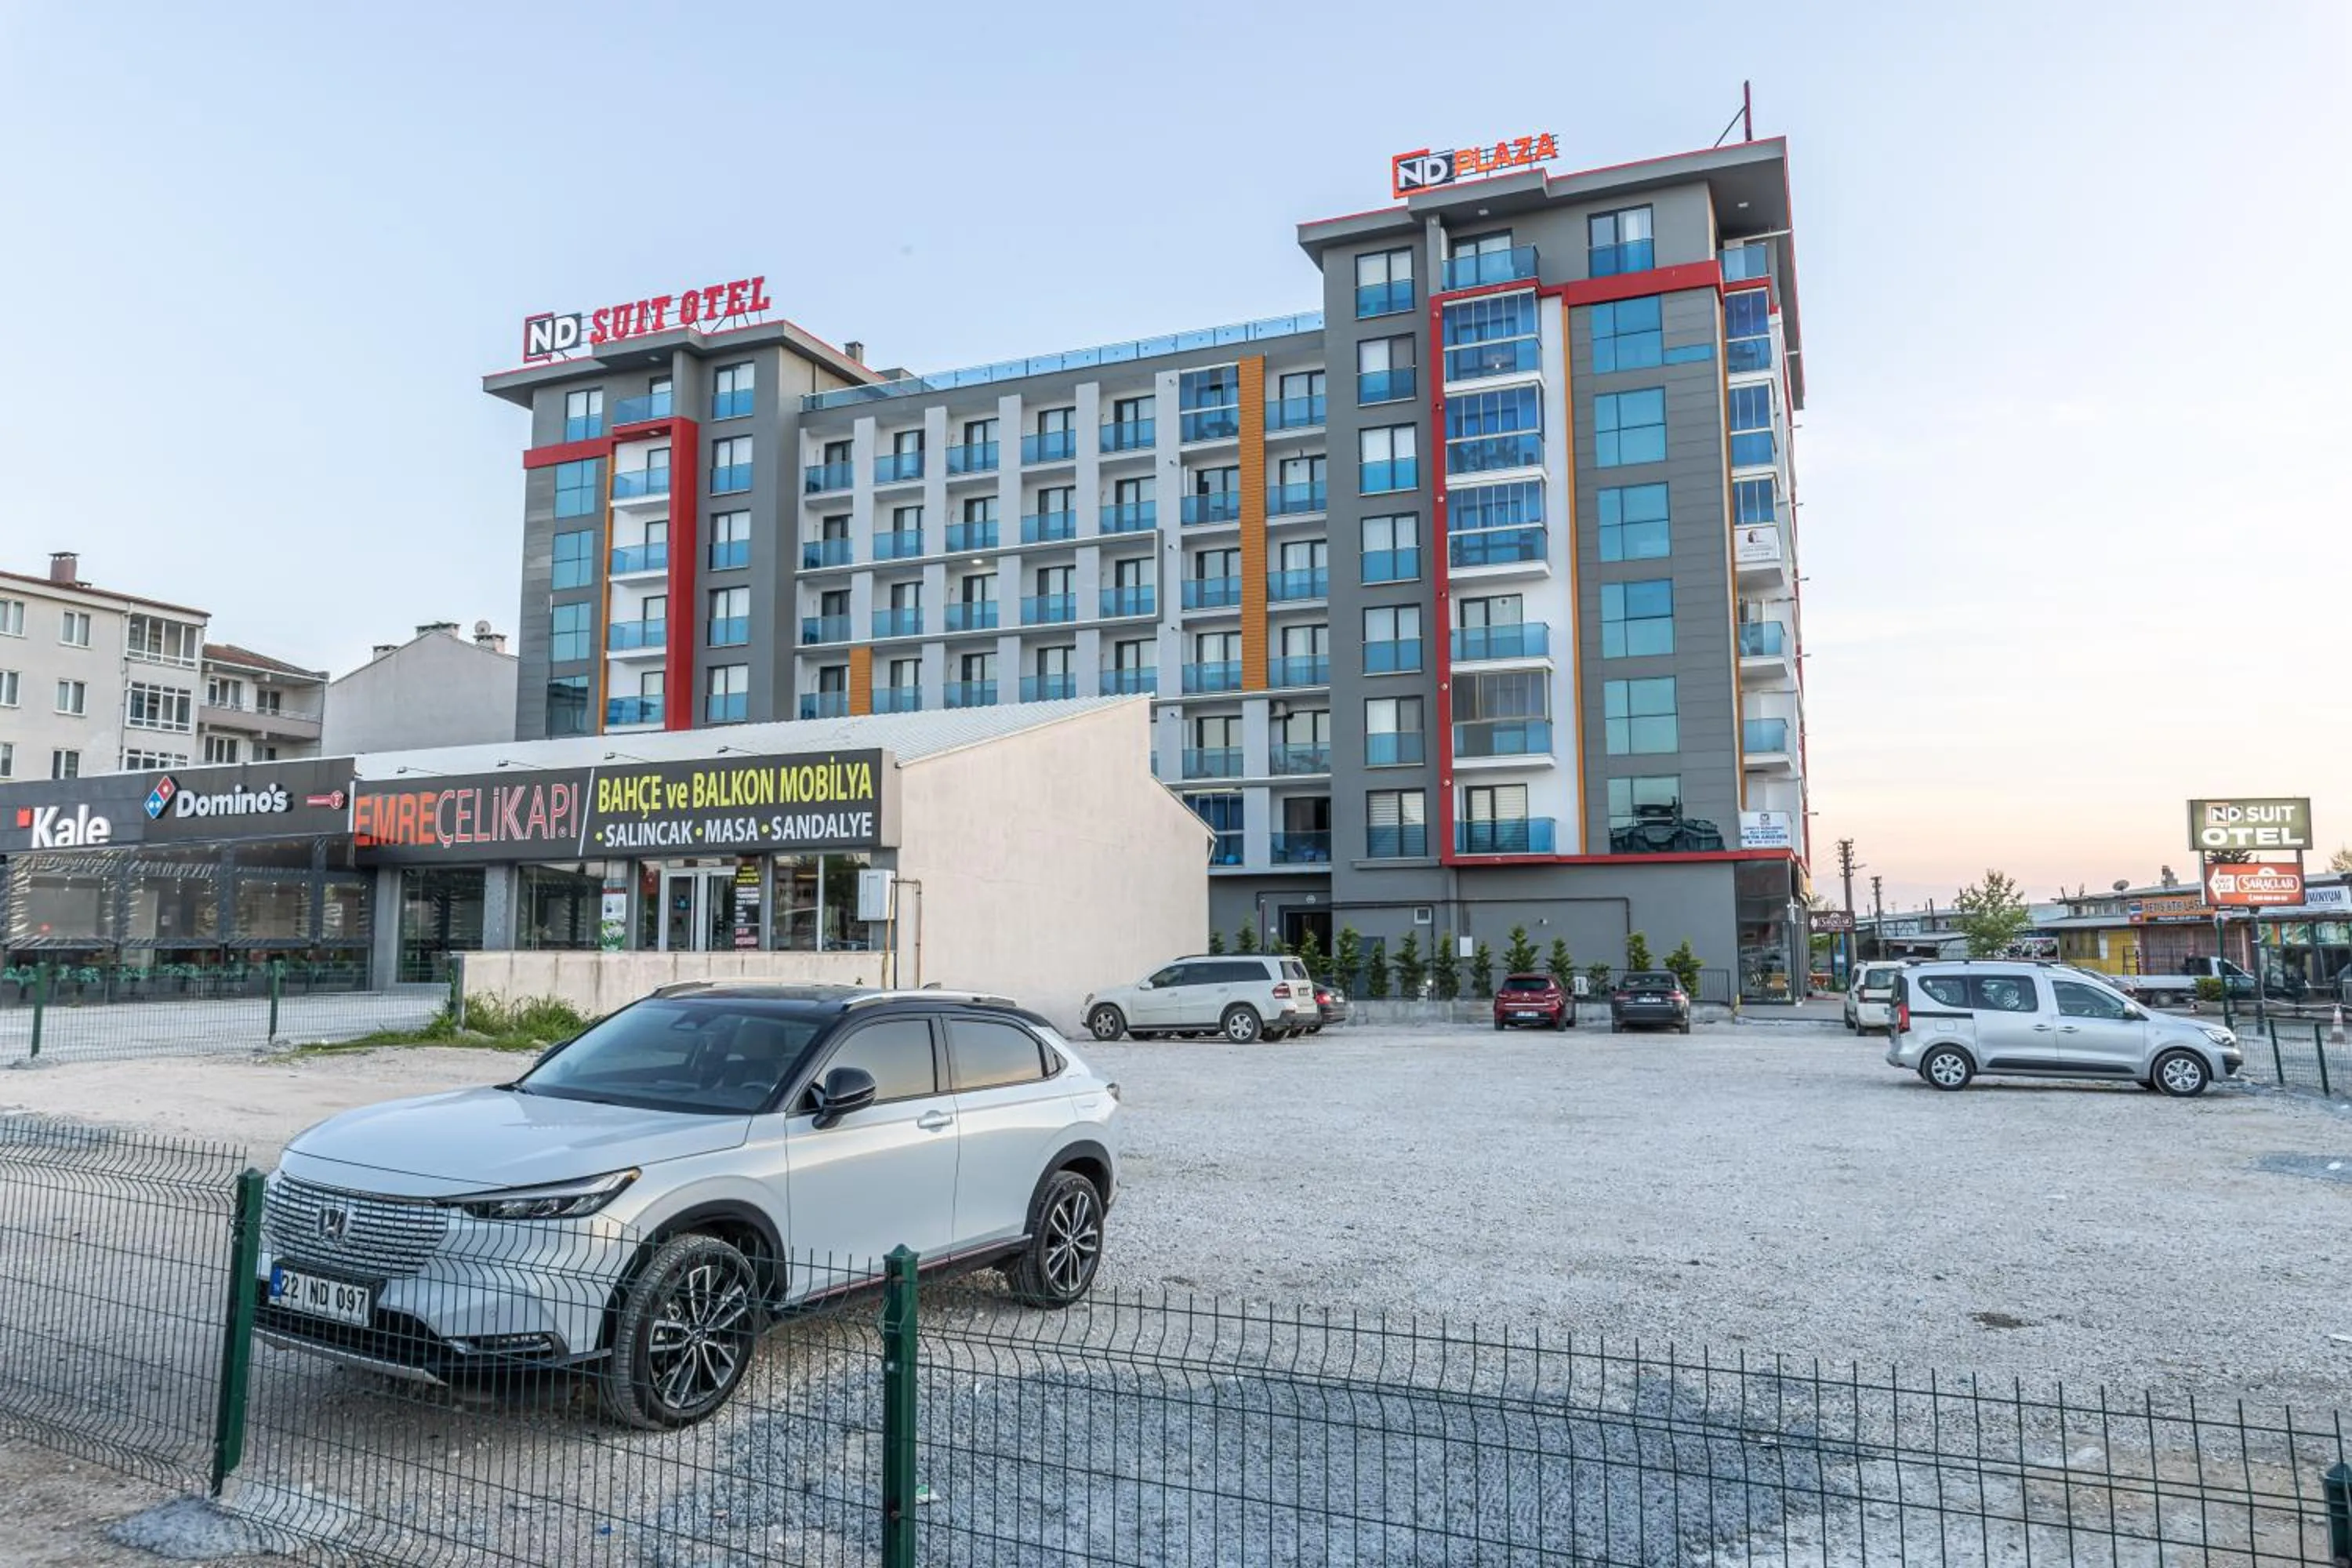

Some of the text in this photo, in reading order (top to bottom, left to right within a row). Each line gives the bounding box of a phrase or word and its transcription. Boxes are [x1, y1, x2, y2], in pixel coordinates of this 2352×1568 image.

[1398, 133, 1558, 188] ND PLAZA
[528, 276, 771, 355] ND SUIT OTEL
[176, 783, 289, 818] Domino's
[598, 755, 873, 819] BAHÇE ve BALKON MOBİLYA
[31, 804, 112, 849] Kale
[705, 817, 759, 843] MASA
[771, 812, 873, 840] SANDALYE
[2211, 805, 2296, 822] ND SUIT
[2201, 827, 2305, 846] OTEL
[281, 1274, 365, 1315] 22 ND 097
